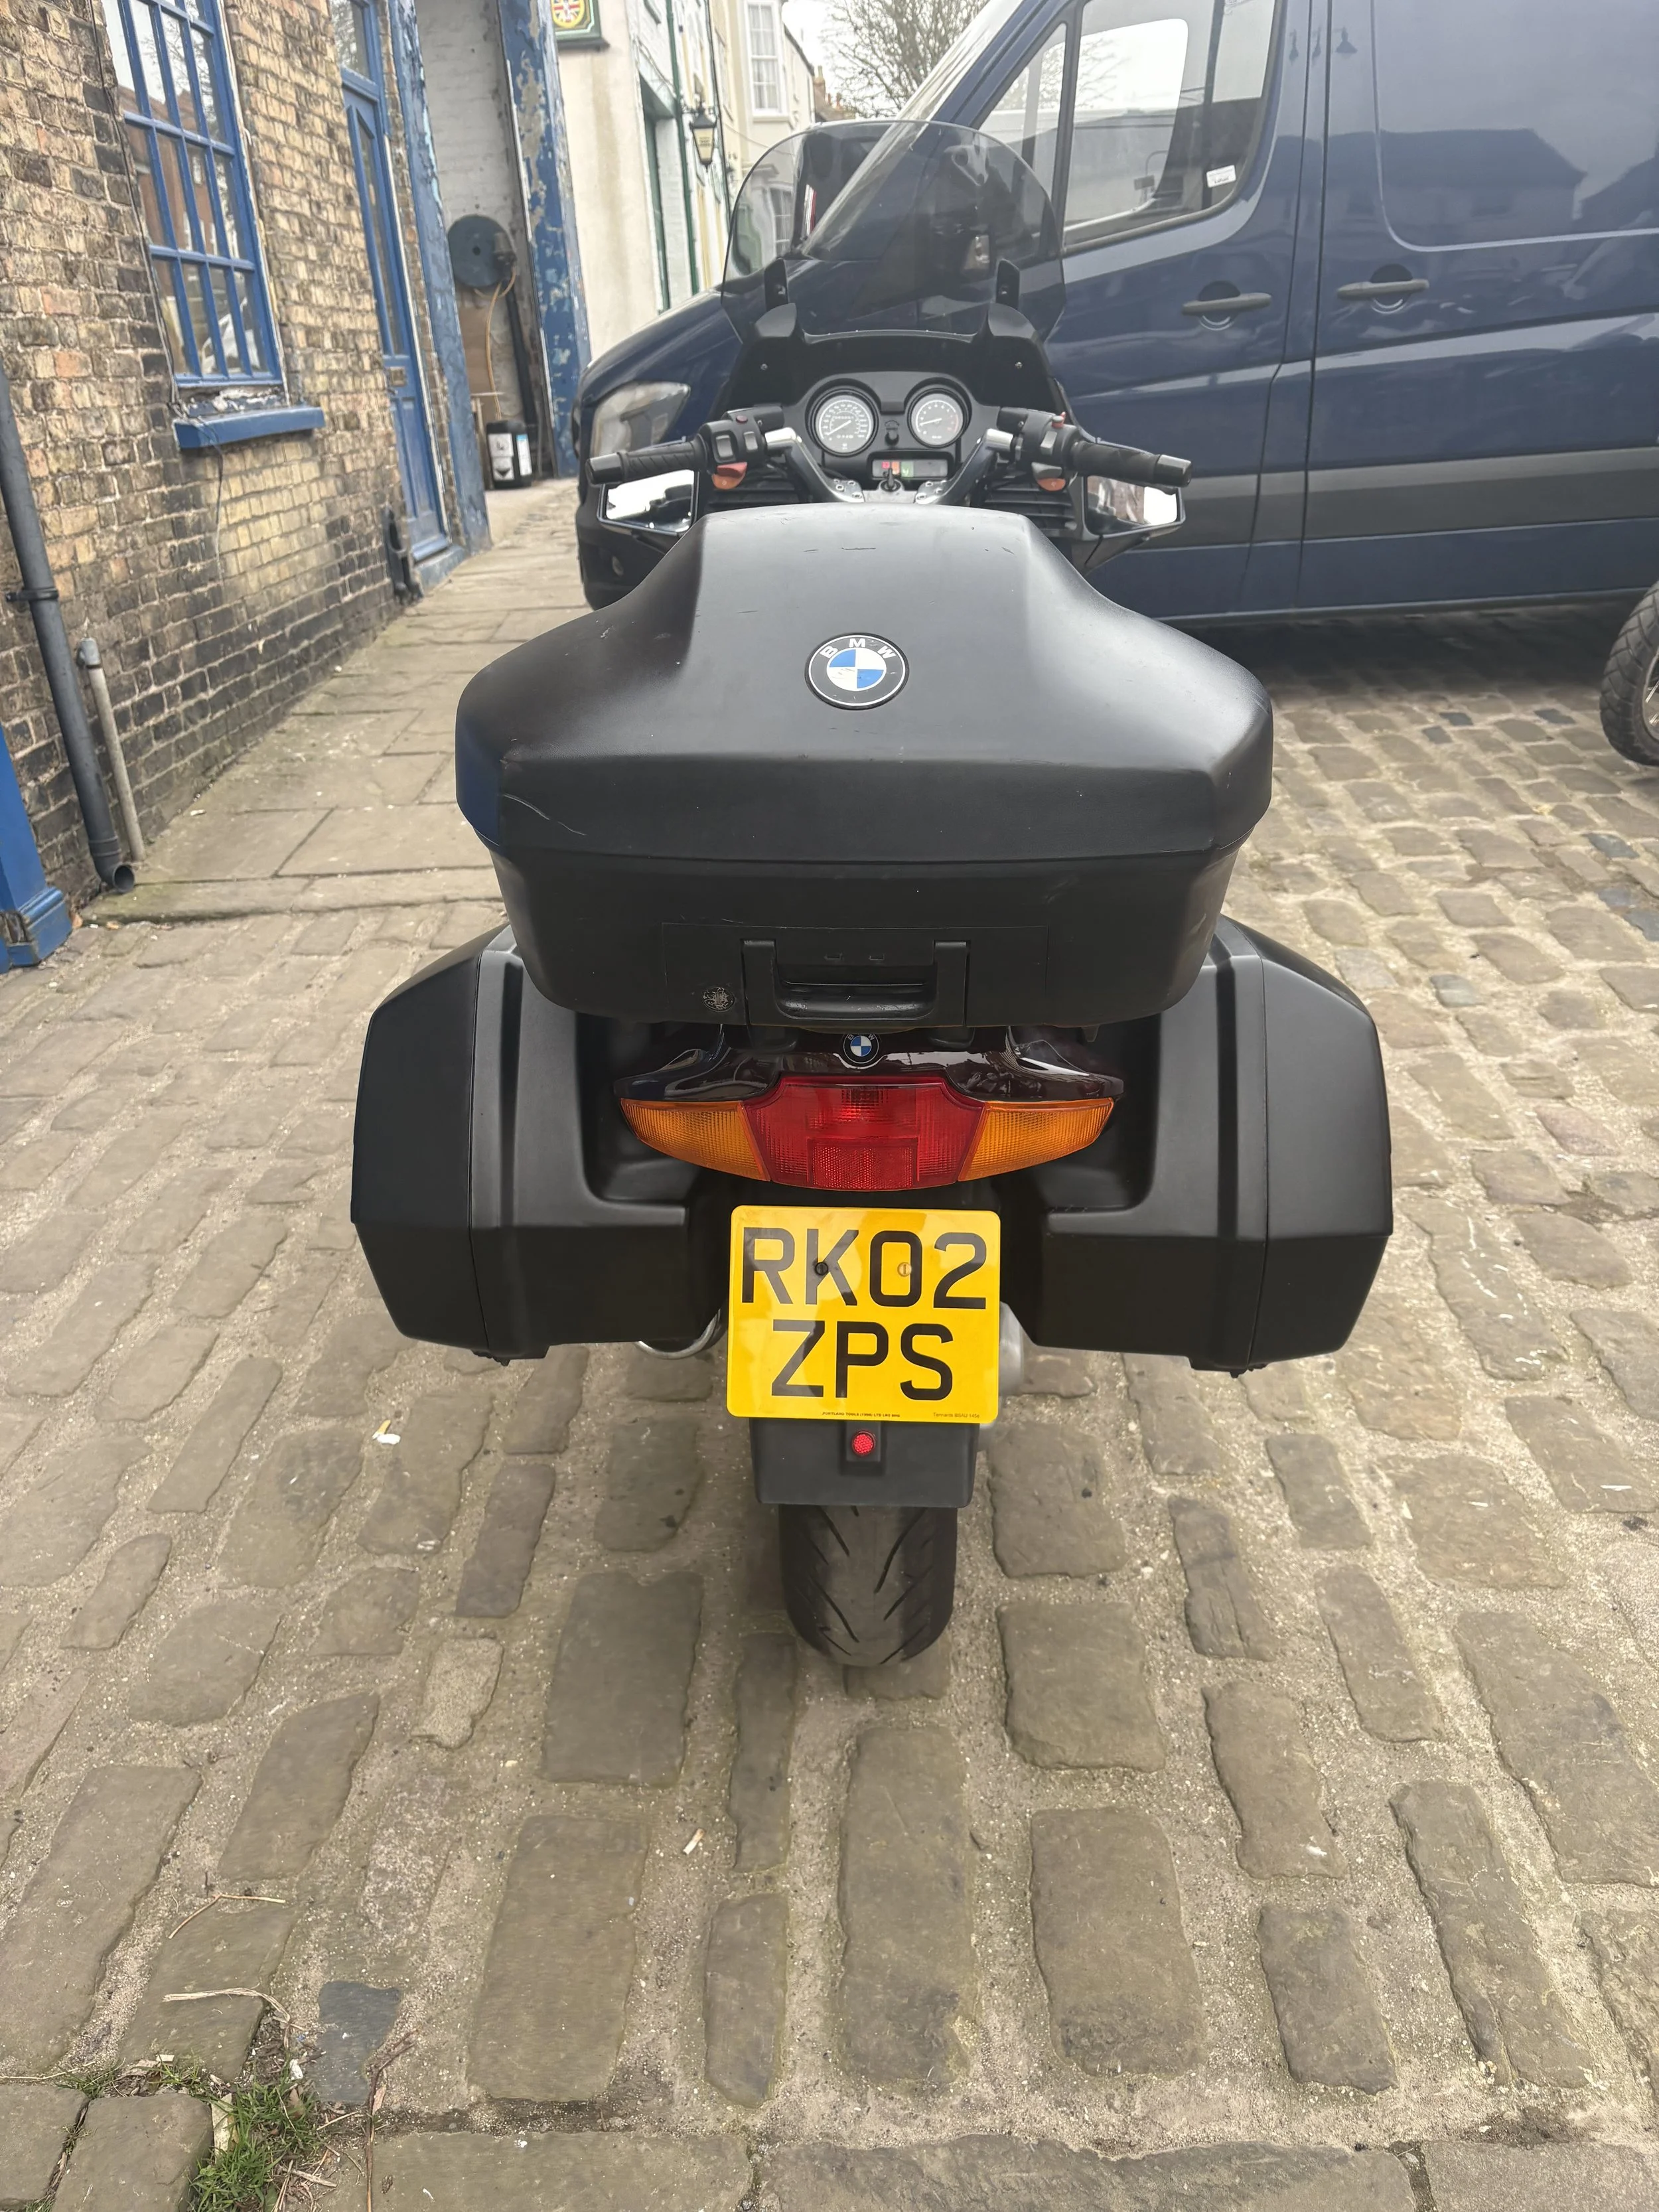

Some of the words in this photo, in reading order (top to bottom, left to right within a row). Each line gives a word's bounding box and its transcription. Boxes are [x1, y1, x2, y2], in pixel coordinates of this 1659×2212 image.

[819, 638, 897, 659] BMW
[741, 1226, 987, 1310] RK02
[771, 1319, 954, 1401] ZPS
